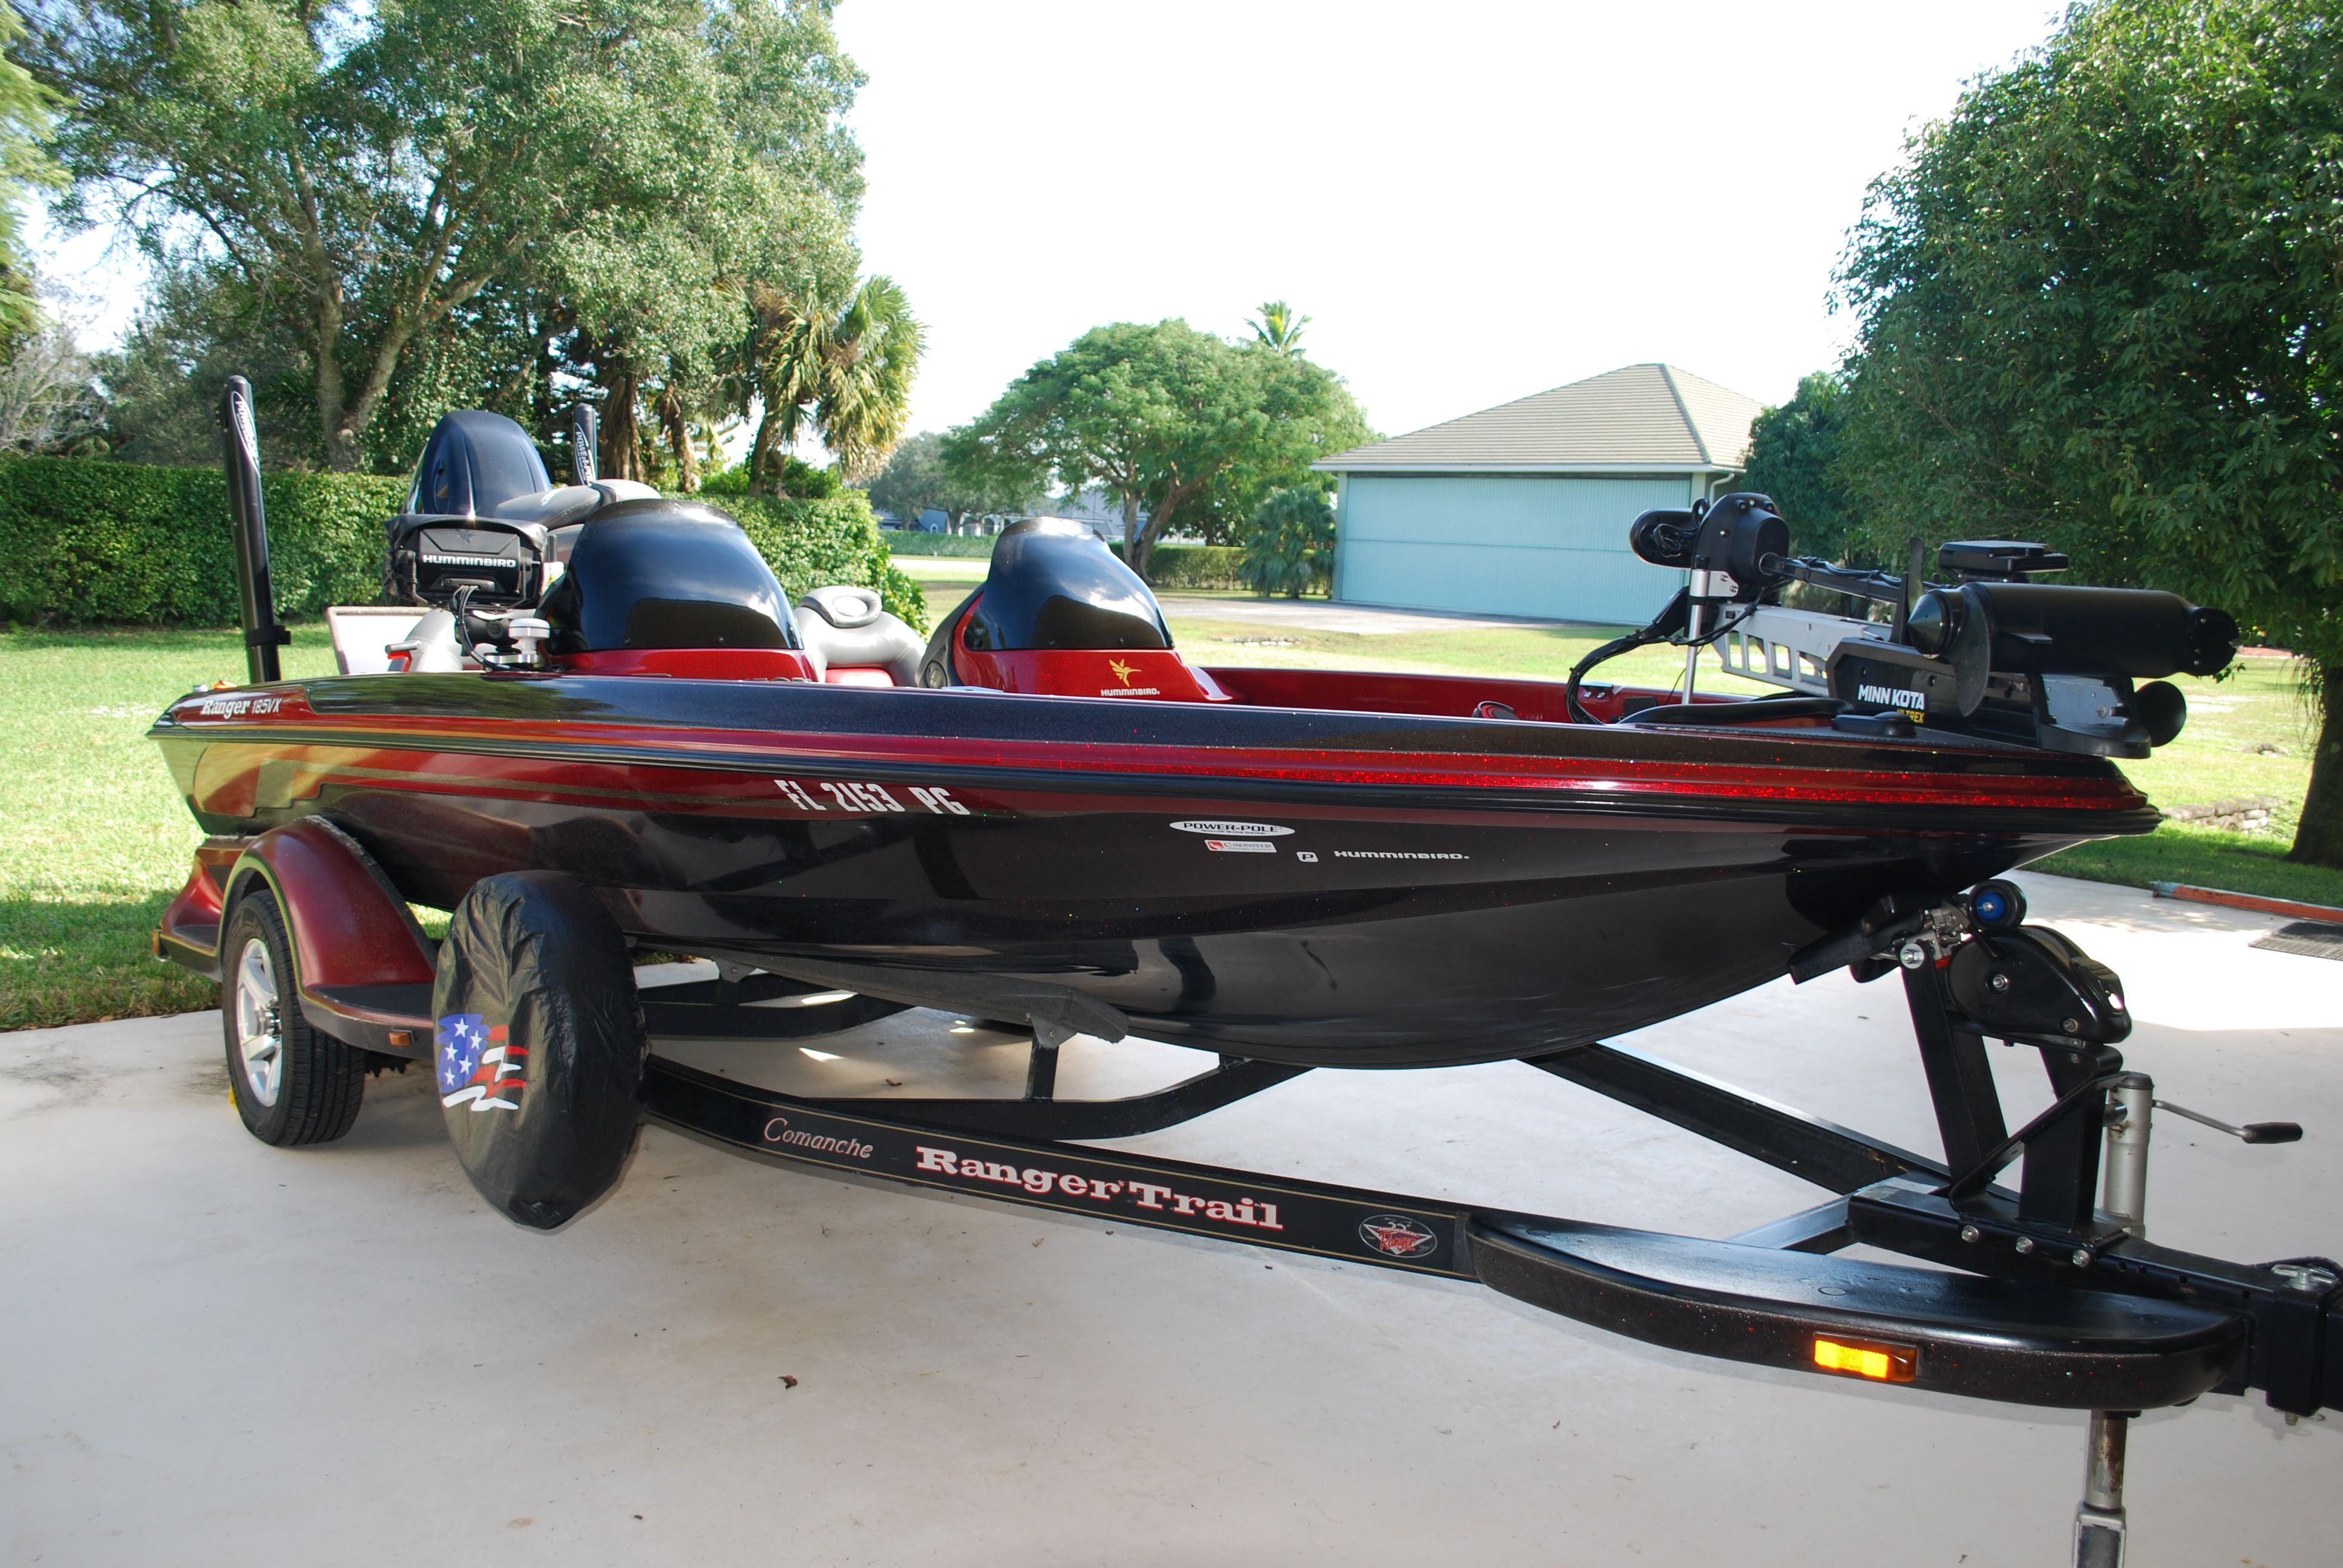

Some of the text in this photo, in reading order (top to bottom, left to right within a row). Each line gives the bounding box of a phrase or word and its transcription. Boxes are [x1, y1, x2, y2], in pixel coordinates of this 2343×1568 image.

[423, 554, 517, 568] HUMMINBIRD
[1858, 684, 1925, 710] MINN KOTA
[200, 698, 283, 719] Ranger 185VX
[1897, 708, 1925, 724] TREX
[774, 780, 971, 815] FL 2153 PG
[1184, 823, 1279, 832] POWER-POLE
[764, 1117, 874, 1159] Comanche
[916, 1145, 1284, 1230] Ranger Trail
[1379, 1231, 1416, 1252] Ranger
